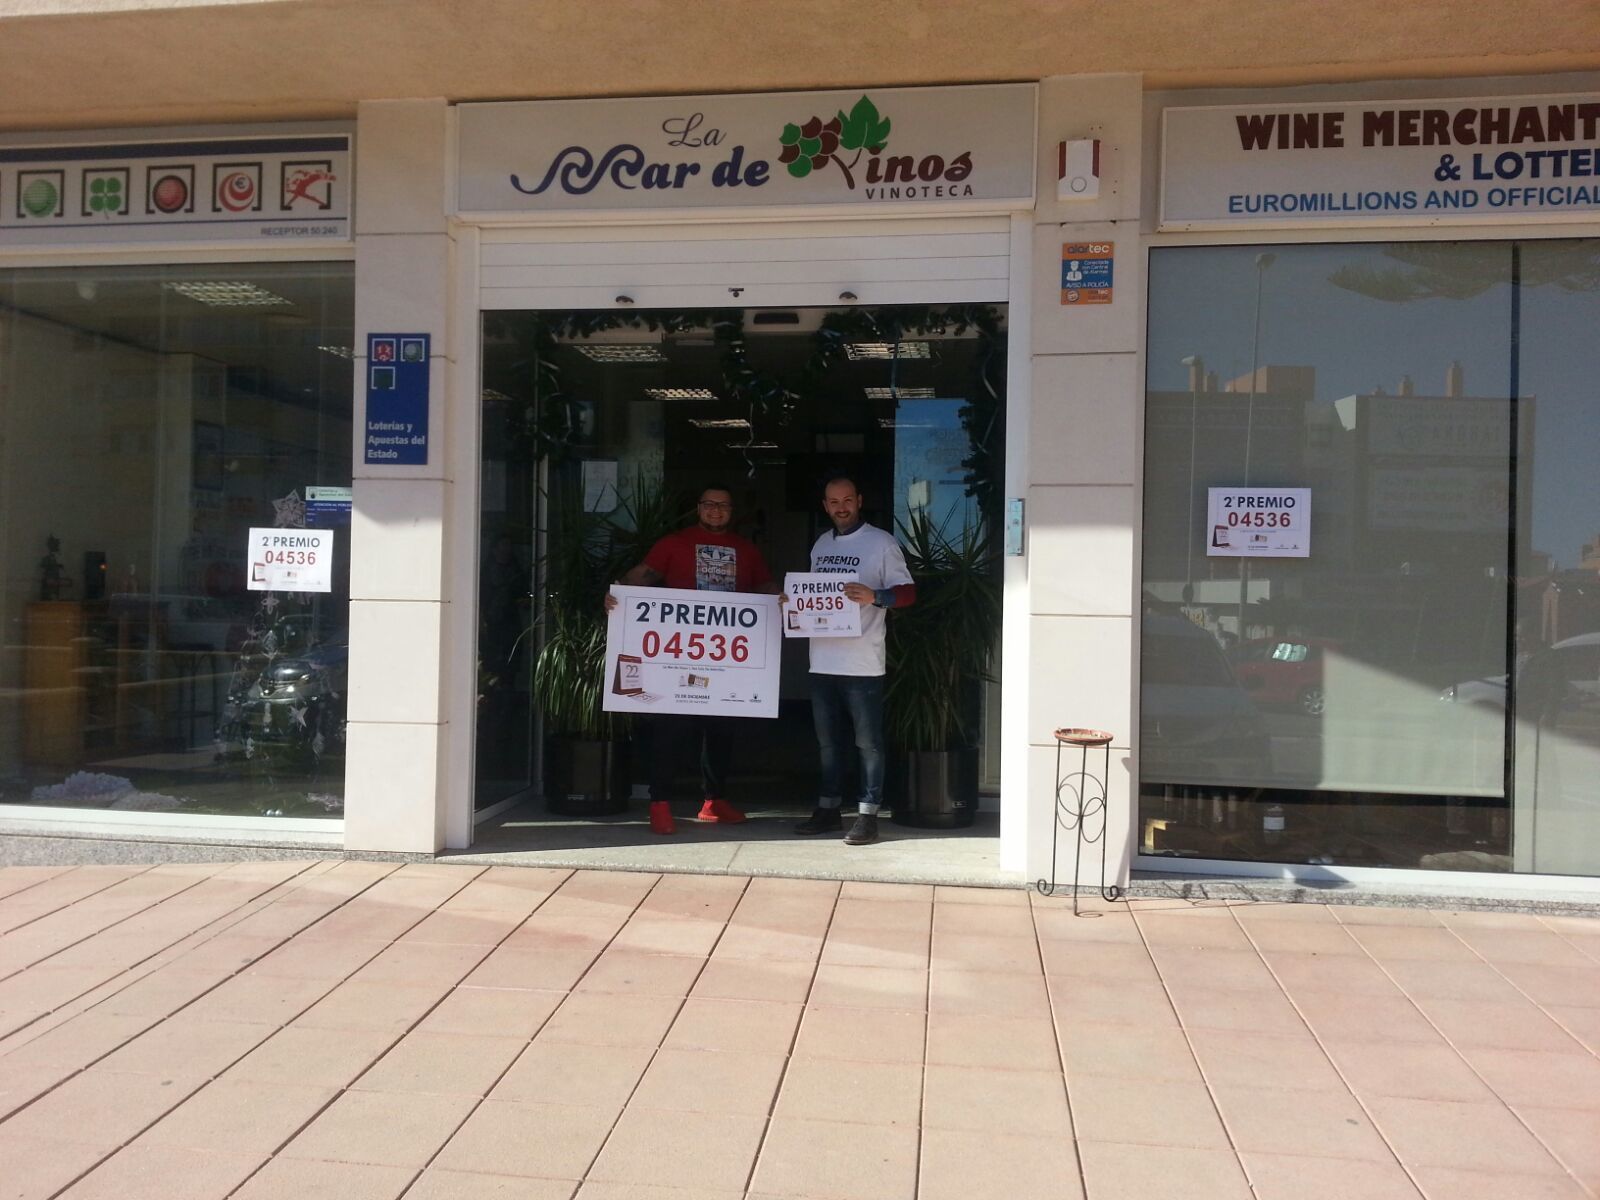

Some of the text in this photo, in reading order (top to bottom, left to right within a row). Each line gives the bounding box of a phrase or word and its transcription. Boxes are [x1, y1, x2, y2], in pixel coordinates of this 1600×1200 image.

[662, 112, 727, 148] La
[1236, 103, 1600, 151] WINE MERCHANT
[711, 145, 770, 188] de
[1434, 148, 1600, 182] & LOTTE
[865, 184, 974, 200] VINOTECA
[1228, 190, 1418, 214] EUROMILLIONS
[1424, 188, 1479, 210] AND
[368, 420, 413, 433] Loterías y
[367, 435, 425, 447] Apuestas del
[367, 449, 398, 459] Estado
[1237, 496, 1296, 509] PREMIO
[1228, 511, 1291, 527] 04536
[273, 536, 321, 548] PREMIO
[265, 550, 316, 565] 04536
[822, 555, 860, 567] PREMIO
[802, 581, 846, 594] PREMIO
[796, 596, 844, 611] 04536
[660, 602, 758, 628] PREMIO
[642, 630, 749, 663] 04536
[625, 664, 640, 678] 22
